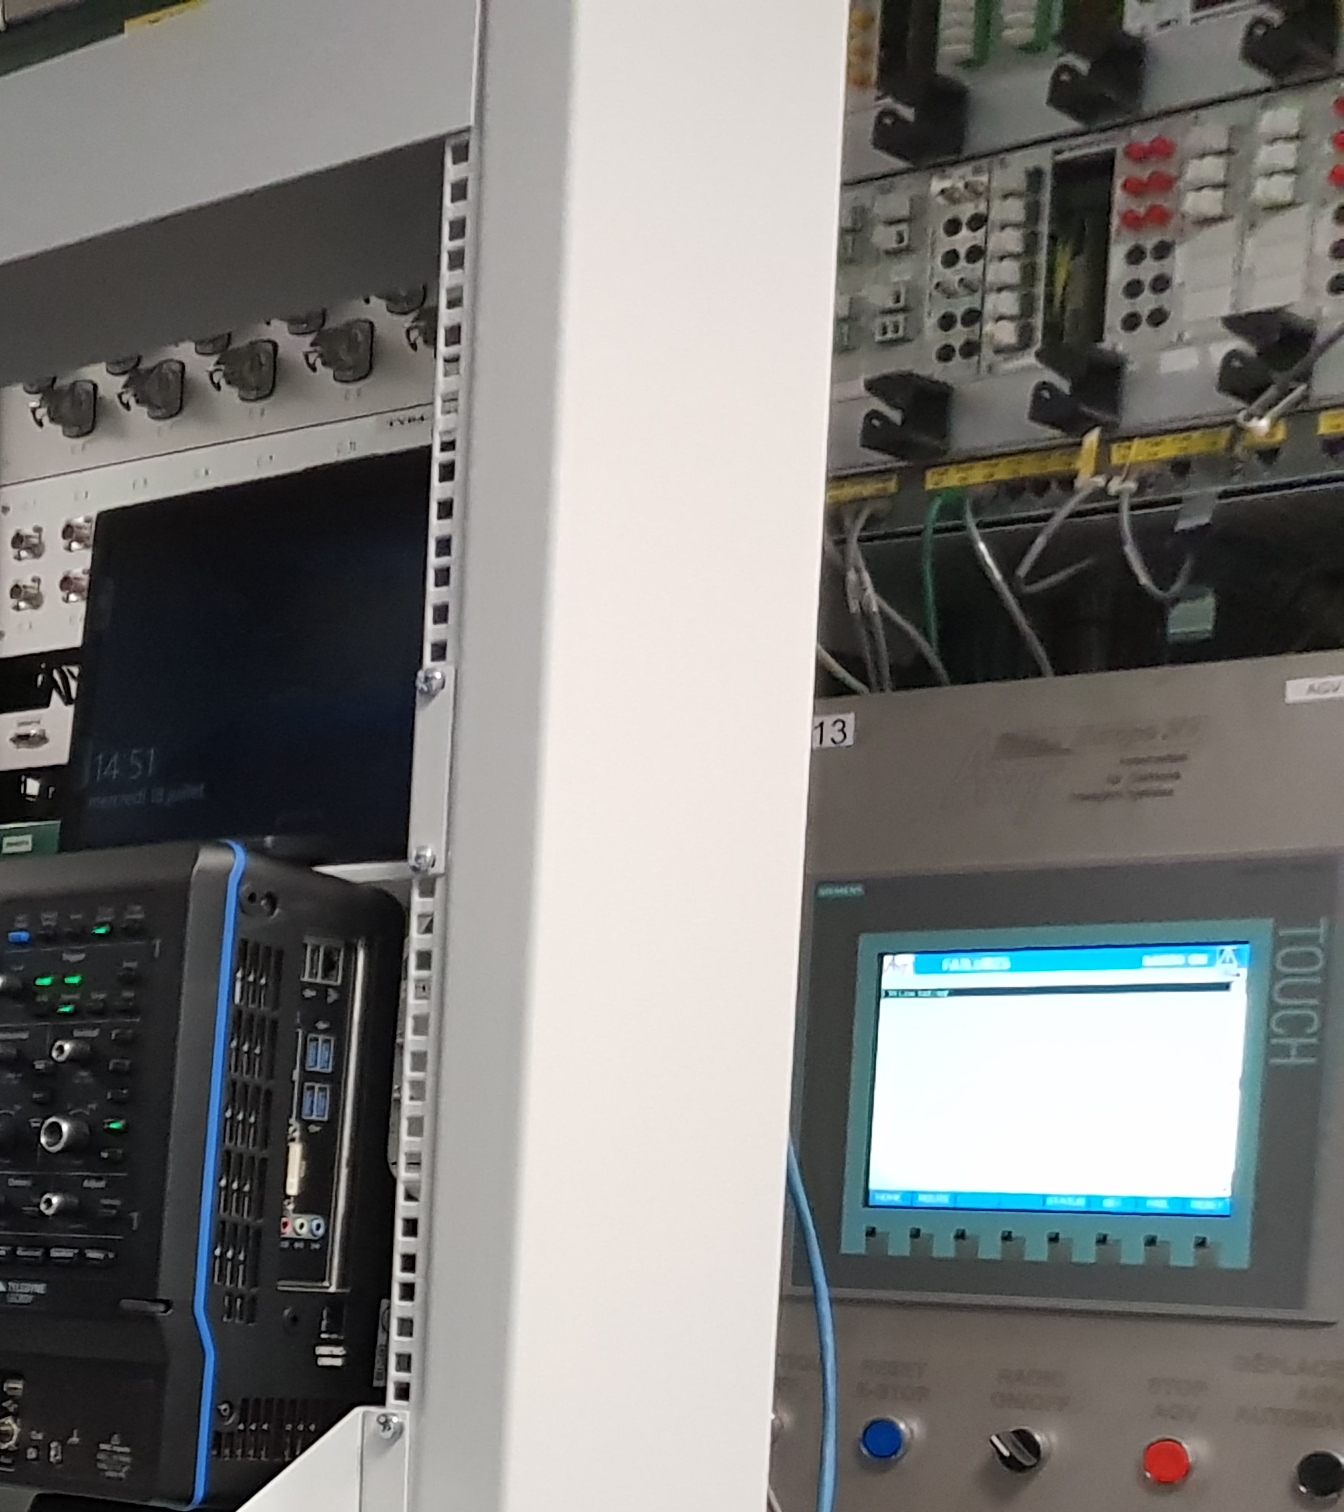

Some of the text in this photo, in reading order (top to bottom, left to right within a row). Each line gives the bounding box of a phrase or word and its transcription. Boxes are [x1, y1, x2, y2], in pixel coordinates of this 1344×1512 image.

[814, 718, 847, 746] 13
[93, 748, 156, 782] 14:51
[1269, 916, 1328, 1065] TOUCH
